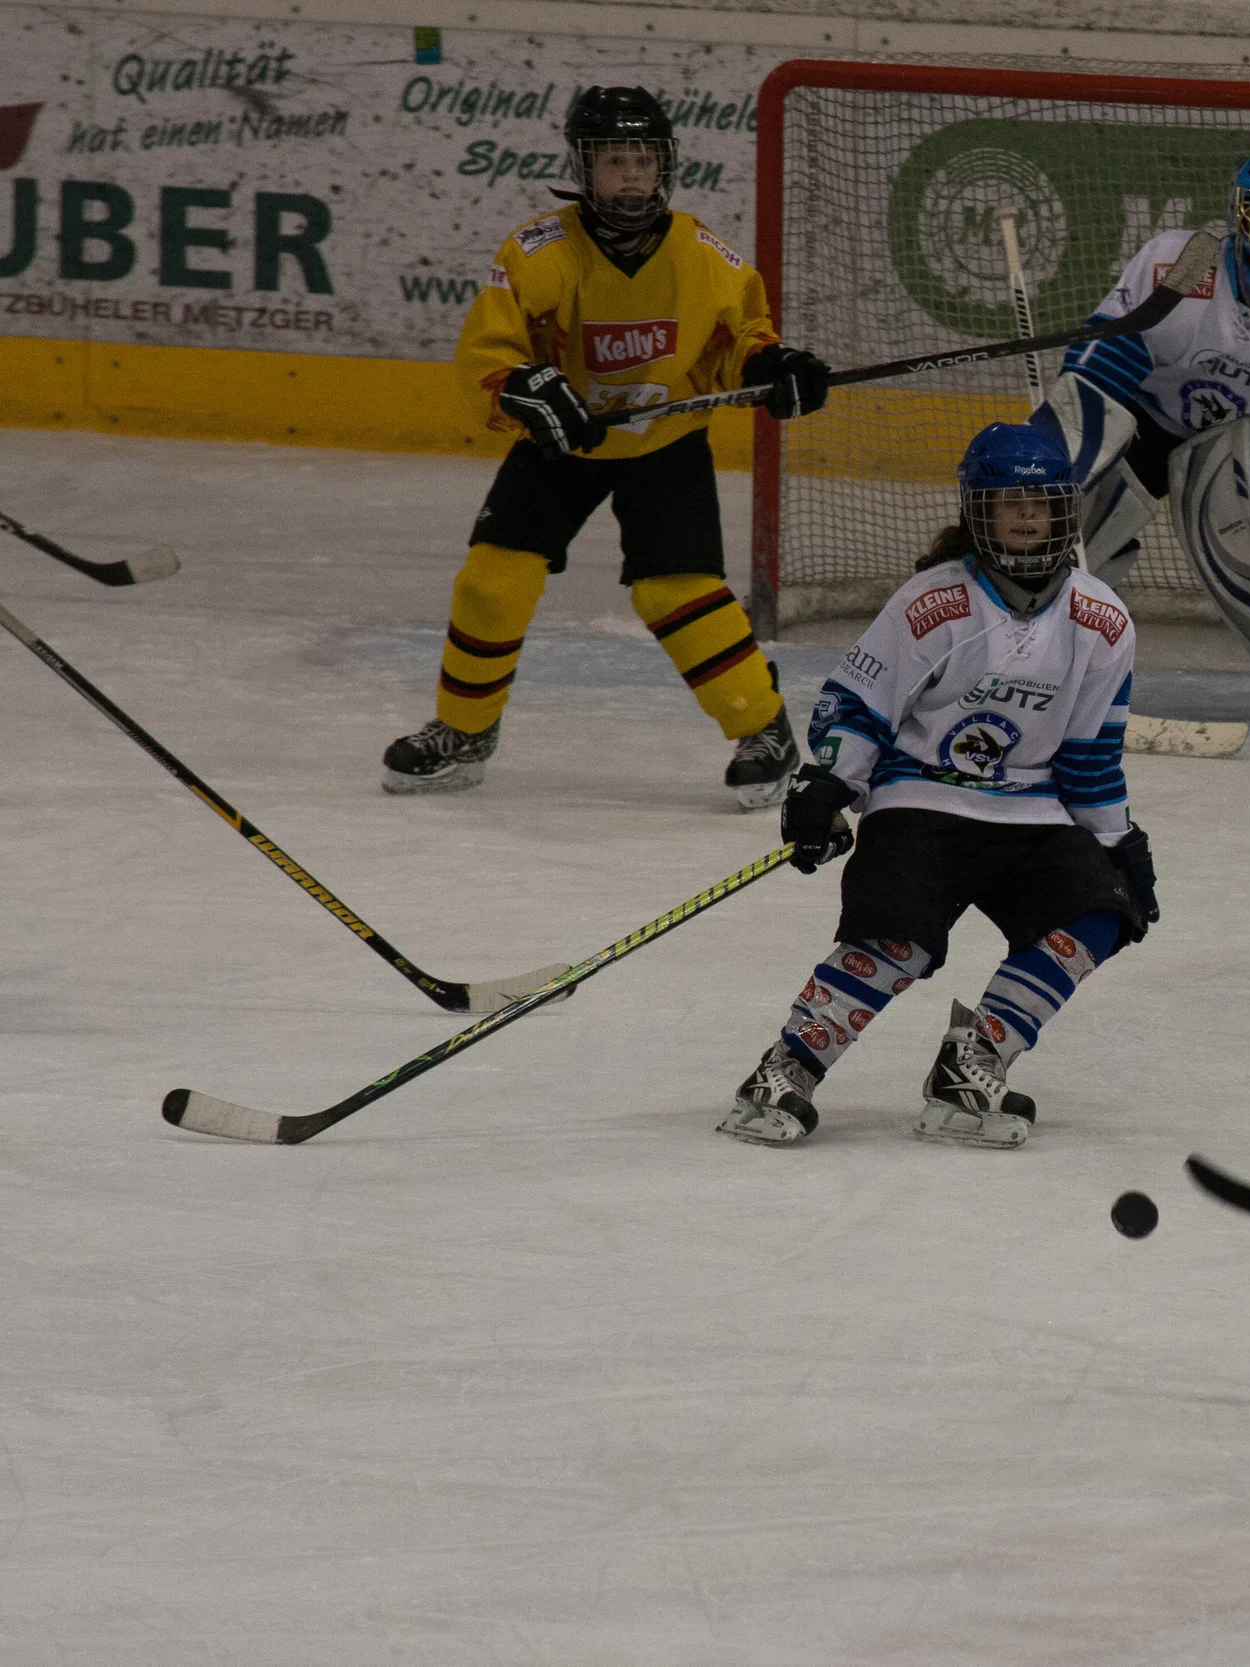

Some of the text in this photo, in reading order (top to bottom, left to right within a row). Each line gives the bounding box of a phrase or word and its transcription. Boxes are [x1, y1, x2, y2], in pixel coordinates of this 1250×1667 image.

[113, 41, 295, 104] Qualität
[402, 75, 554, 127] Original
[68, 109, 349, 152] hat einen Namen
[700, 232, 740, 266] RICOH
[0, 291, 334, 332] ZBÜHELER METZGER
[593, 325, 667, 362] Kelly's
[905, 352, 989, 371] VAPOR
[1014, 463, 1047, 475] Reebok
[907, 585, 966, 621] KLEINE
[914, 601, 970, 635] ZEITUNG
[1074, 593, 1128, 630] KLEINE
[1073, 604, 1119, 643] ZEITUNG
[248, 834, 375, 940] WARRIOR
